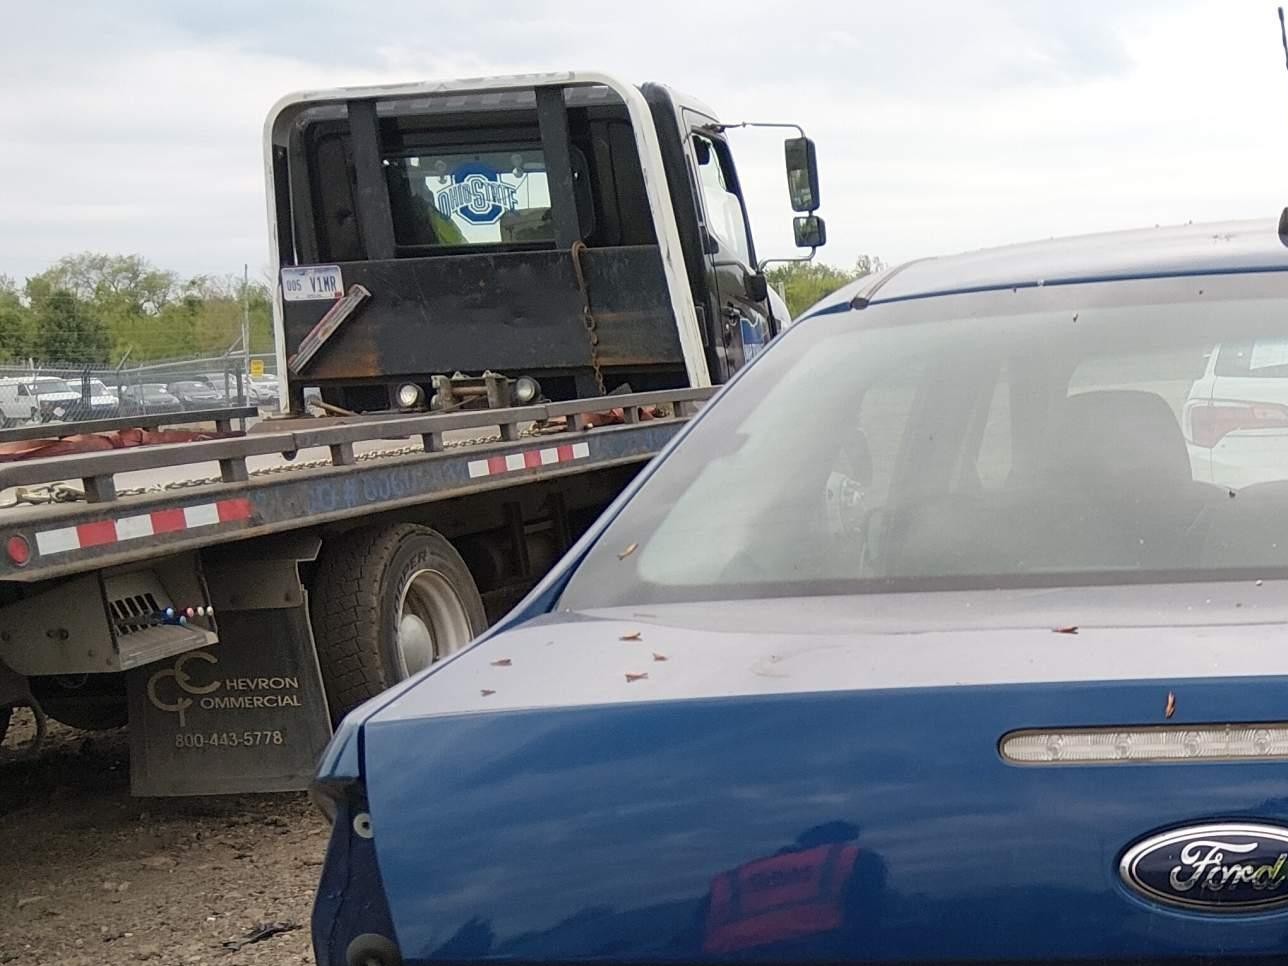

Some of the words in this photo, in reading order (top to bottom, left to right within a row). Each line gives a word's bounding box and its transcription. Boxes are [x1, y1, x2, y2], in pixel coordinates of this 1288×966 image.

[437, 183, 473, 219] OHIO
[470, 178, 519, 213] STATE
[175, 731, 284, 748] 800-443-5778
[1169, 840, 1288, 891] Ford
